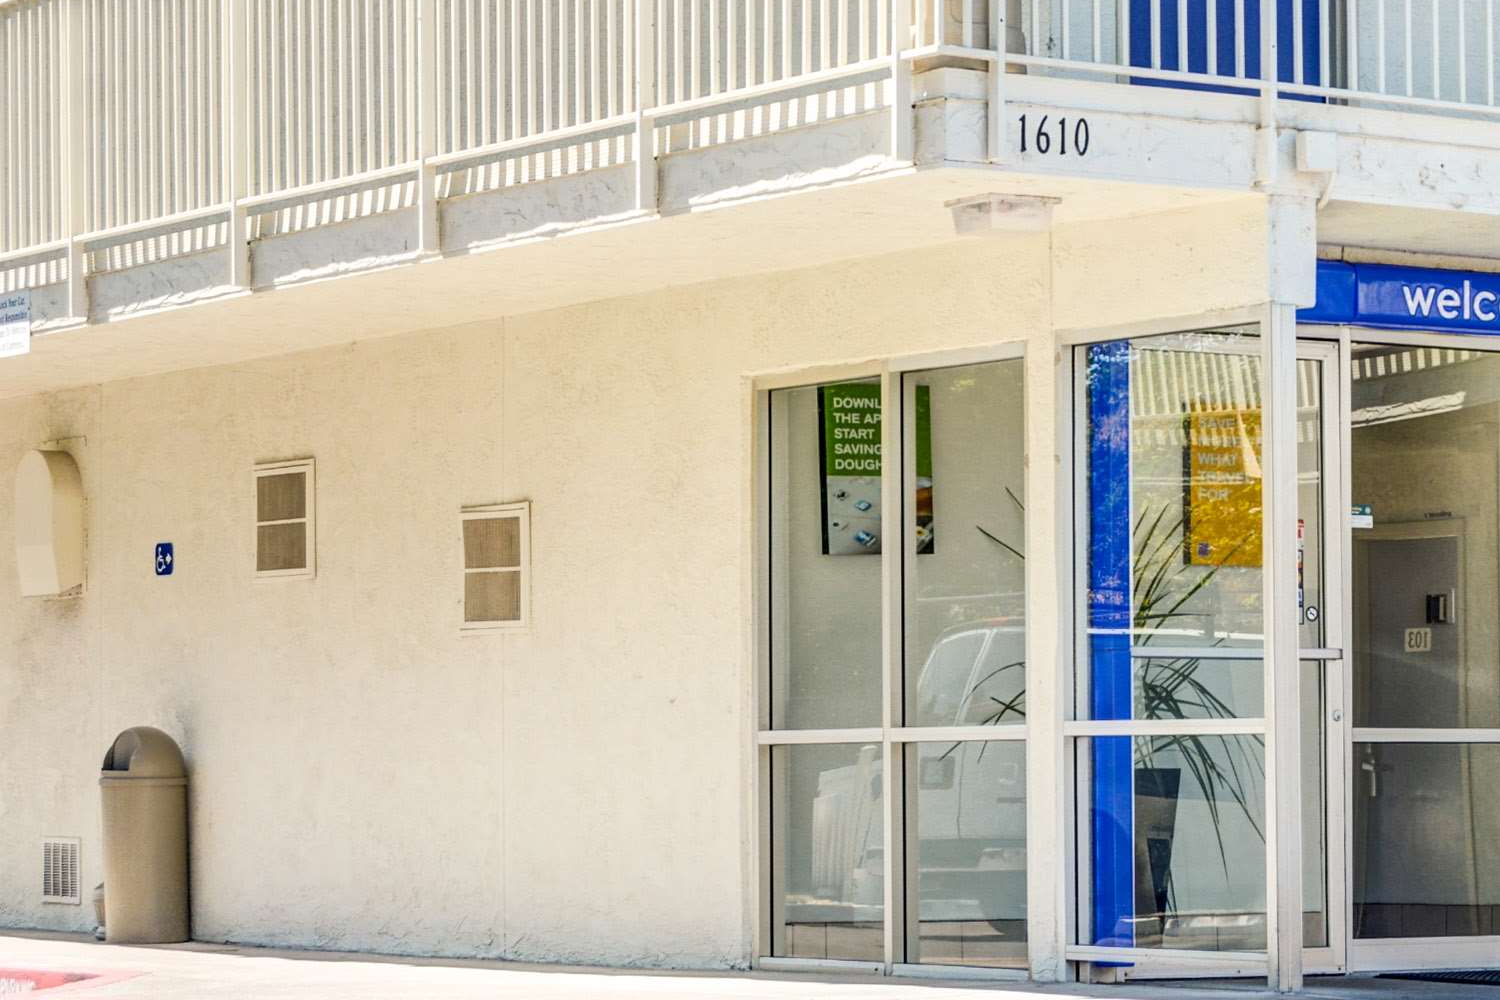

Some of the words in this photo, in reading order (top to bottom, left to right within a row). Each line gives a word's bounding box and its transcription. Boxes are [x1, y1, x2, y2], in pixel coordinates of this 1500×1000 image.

[1018, 113, 1089, 156] 1610
[833, 397, 882, 409] DOWNL
[833, 413, 861, 424] THE
[864, 413, 882, 424] AP
[834, 428, 875, 439] START
[1199, 487, 1230, 500] FOR
